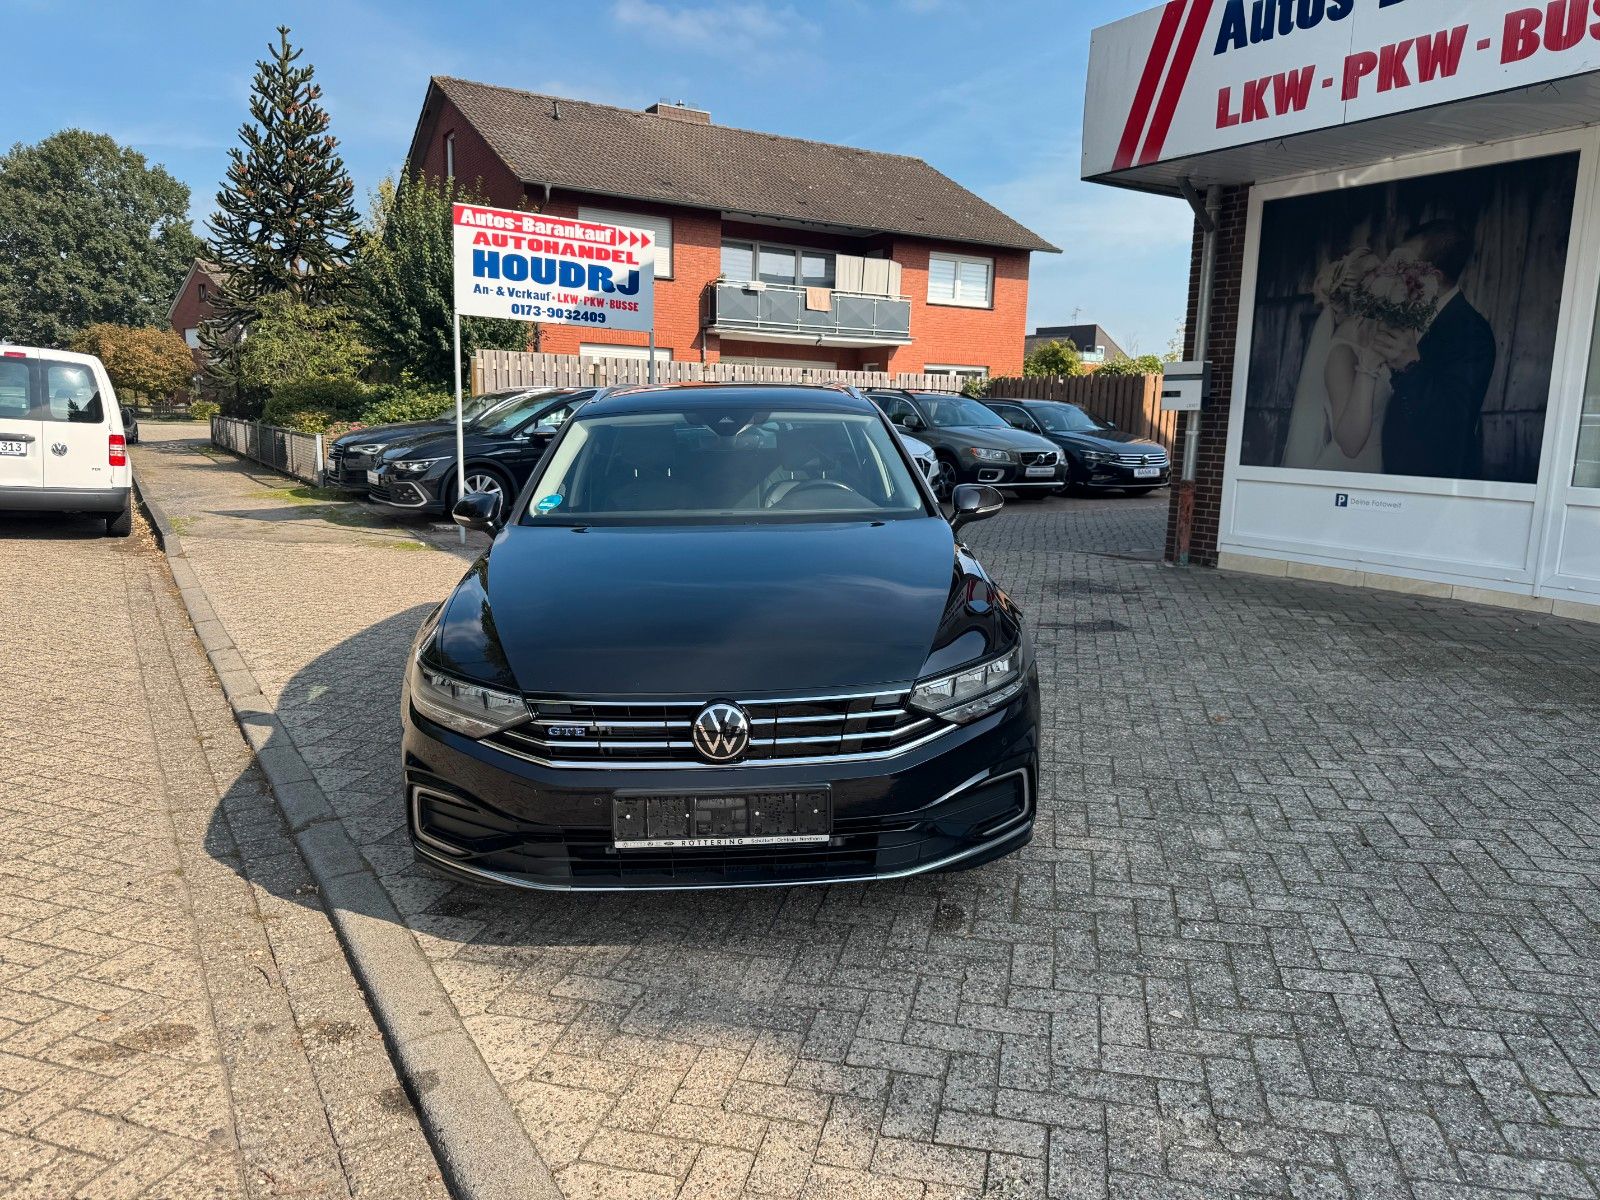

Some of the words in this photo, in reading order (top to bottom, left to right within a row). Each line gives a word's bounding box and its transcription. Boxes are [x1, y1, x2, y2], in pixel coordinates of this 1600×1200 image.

[1213, 0, 1354, 56] Autos
[1215, 64, 1316, 130] LKW
[1342, 24, 1470, 101] PKW
[1500, 0, 1600, 65] BU
[460, 208, 614, 243] Autos-Barankauf
[472, 231, 640, 266] AUTOHANDEL
[472, 249, 640, 296] HOUDRJ
[473, 283, 494, 295] An-
[507, 287, 552, 301] Verkauf
[557, 293, 579, 305] LKW
[584, 296, 605, 308] PKW
[609, 299, 640, 312] BUSSE
[511, 303, 607, 324] 0173-9032409
[548, 726, 586, 737] GTE
